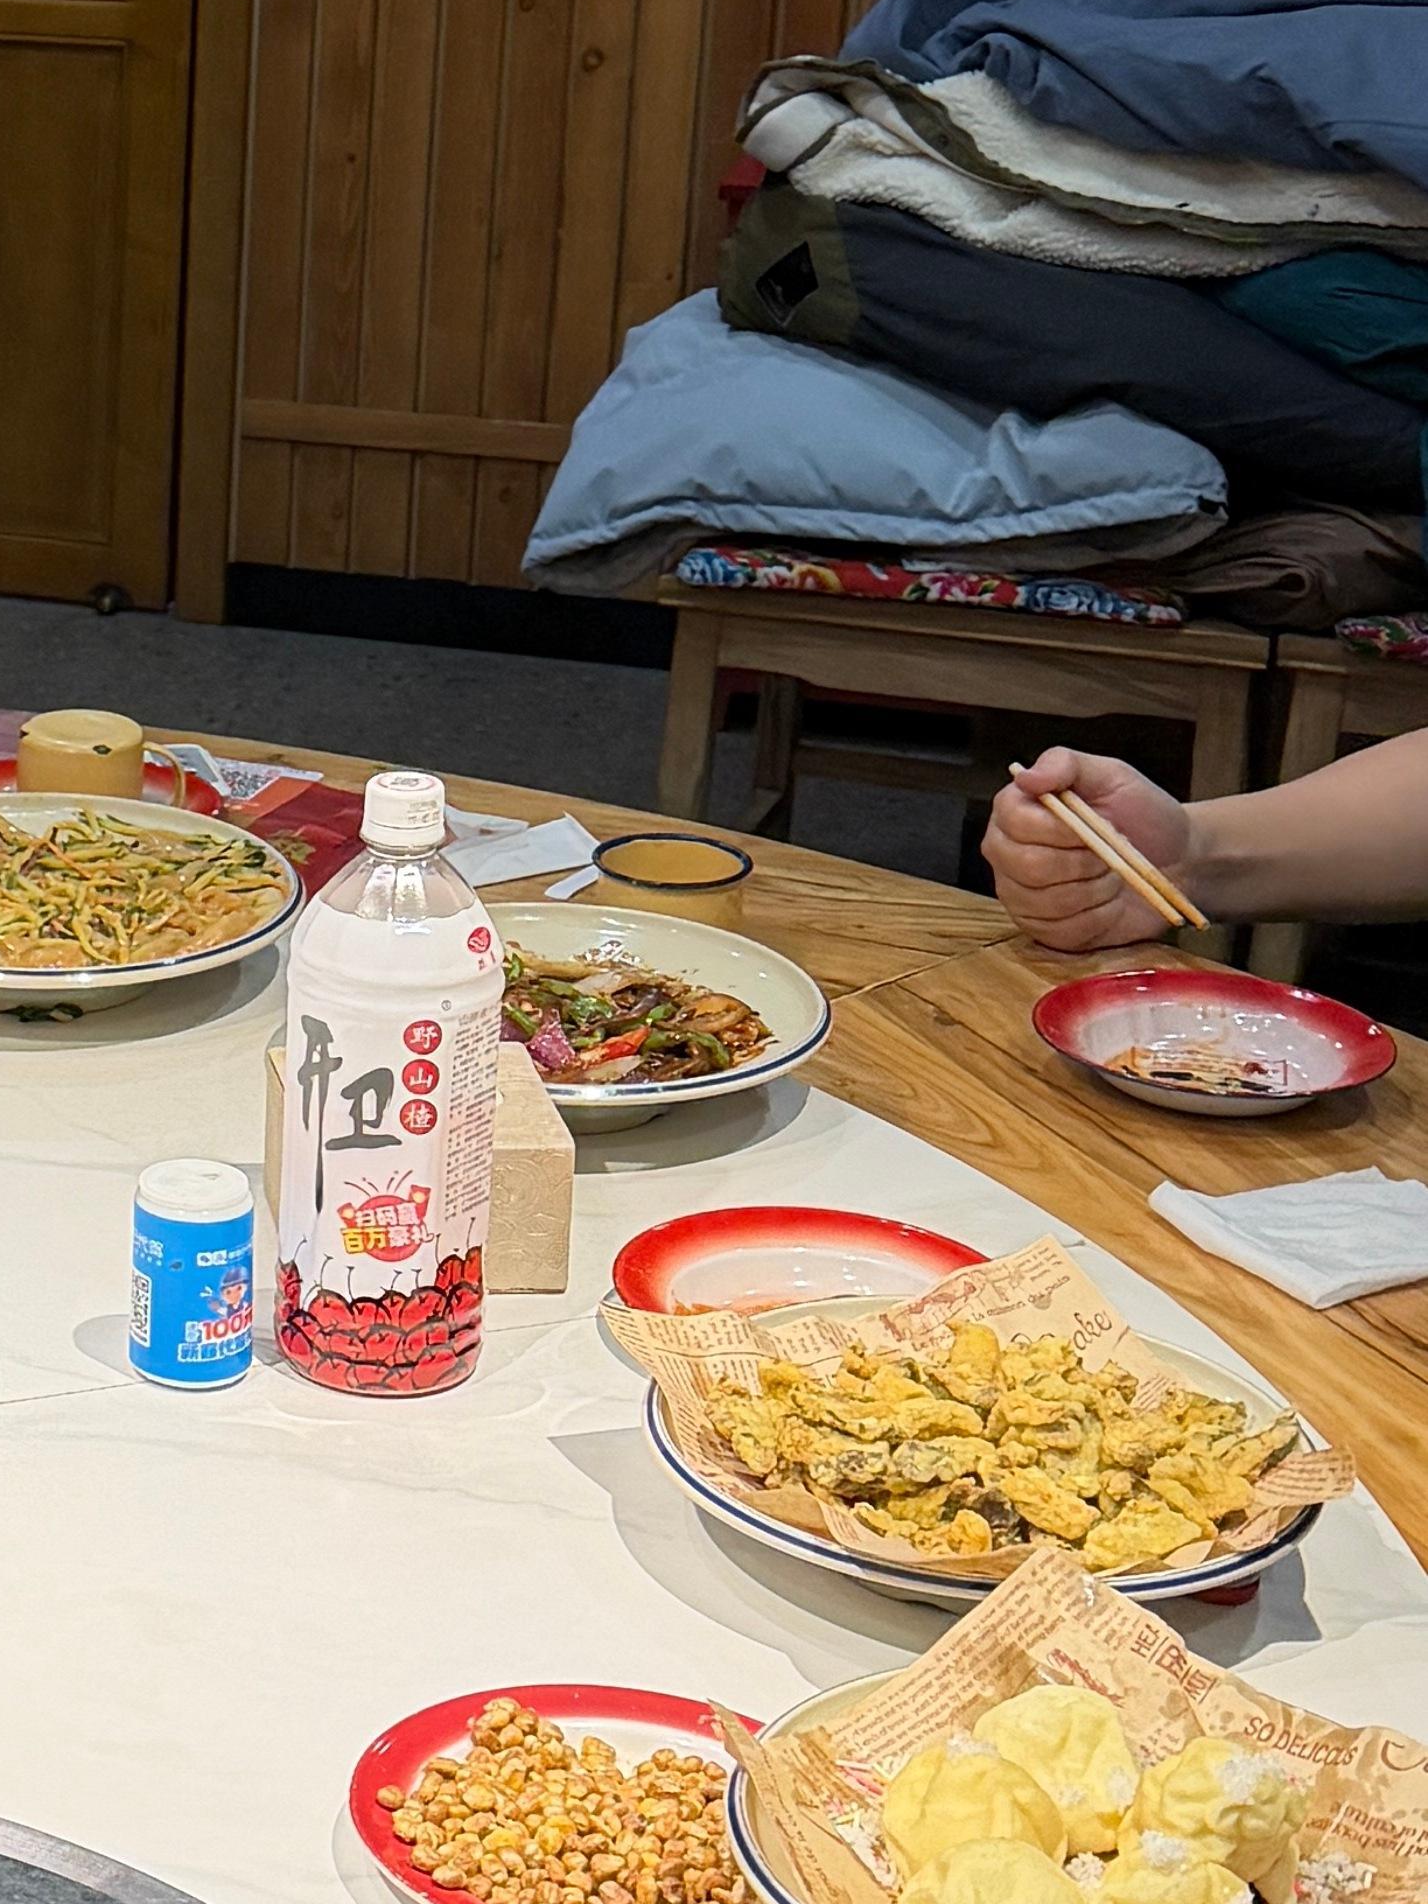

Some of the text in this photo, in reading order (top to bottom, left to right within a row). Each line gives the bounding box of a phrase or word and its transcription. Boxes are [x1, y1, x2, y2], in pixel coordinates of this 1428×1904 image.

[405, 1024, 439, 1129] 野山楂
[1244, 1716, 1276, 1743] SO
